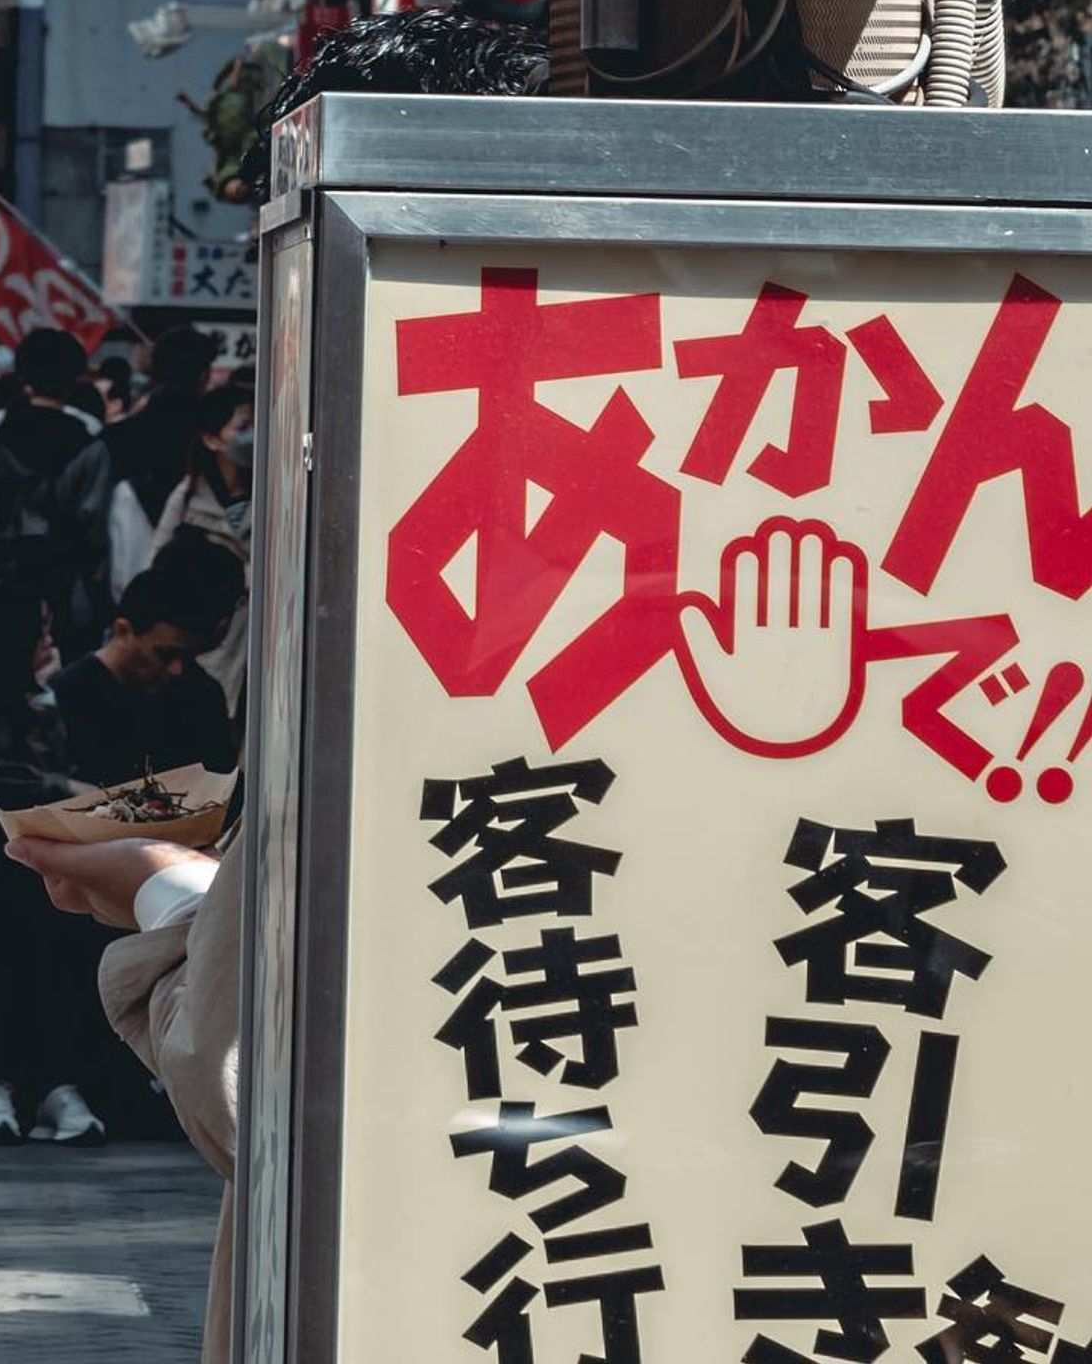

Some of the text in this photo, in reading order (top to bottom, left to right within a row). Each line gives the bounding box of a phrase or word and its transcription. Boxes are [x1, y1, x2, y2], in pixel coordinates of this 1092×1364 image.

[419, 756, 665, 1364] 客待ち行
[733, 818, 1008, 1364] 客引き
